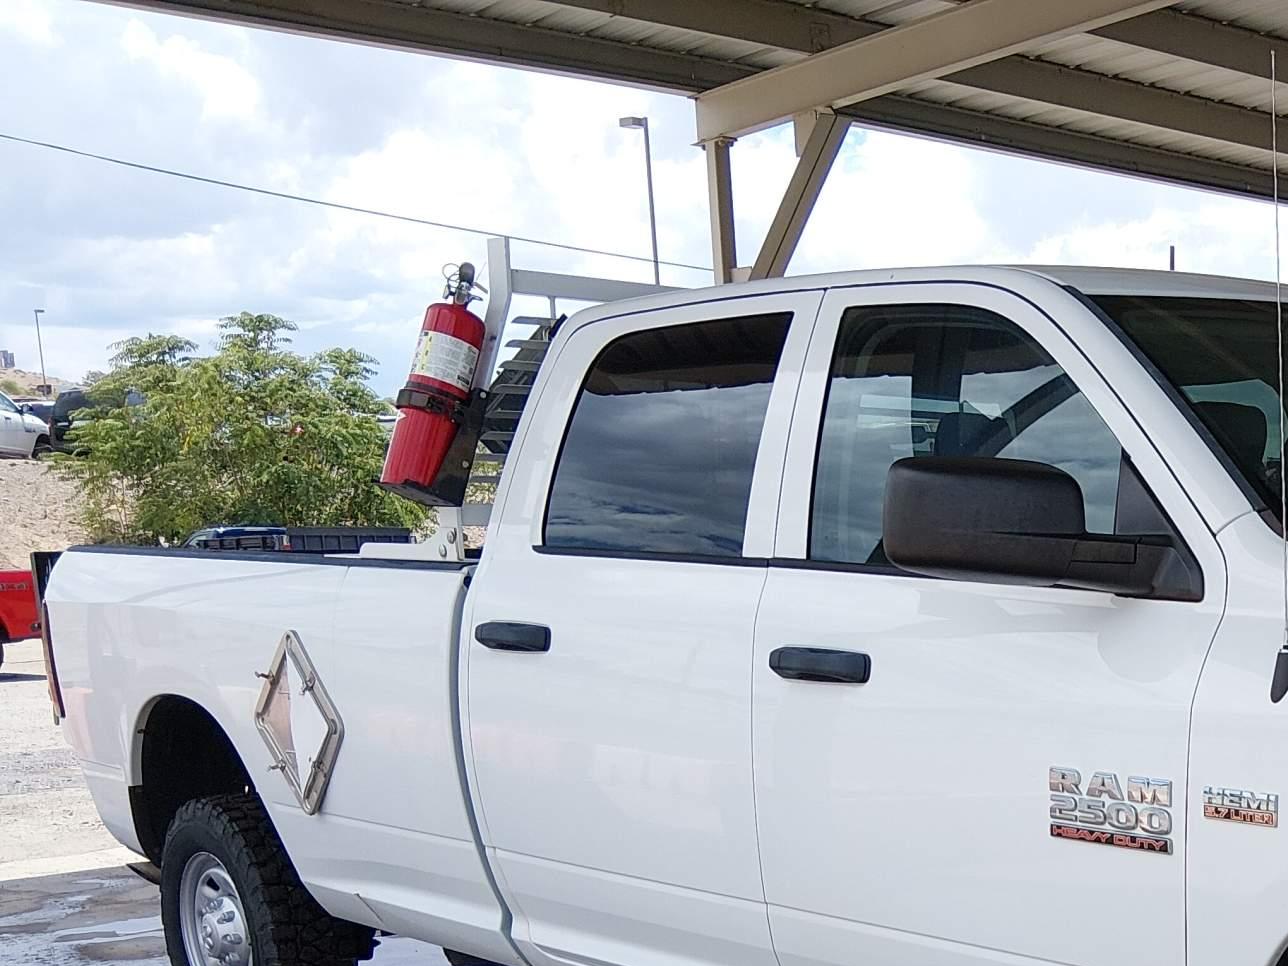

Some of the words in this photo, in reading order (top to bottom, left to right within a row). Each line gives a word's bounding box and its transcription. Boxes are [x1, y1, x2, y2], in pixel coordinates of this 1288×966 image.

[1049, 766, 1172, 807] RAM
[1203, 786, 1278, 812] HEMI
[1050, 794, 1173, 835] 2500
[1204, 806, 1228, 818] 5.7
[1230, 809, 1274, 826] LITER
[1052, 825, 1111, 843] HEAVY
[1113, 834, 1165, 850] DUTY
